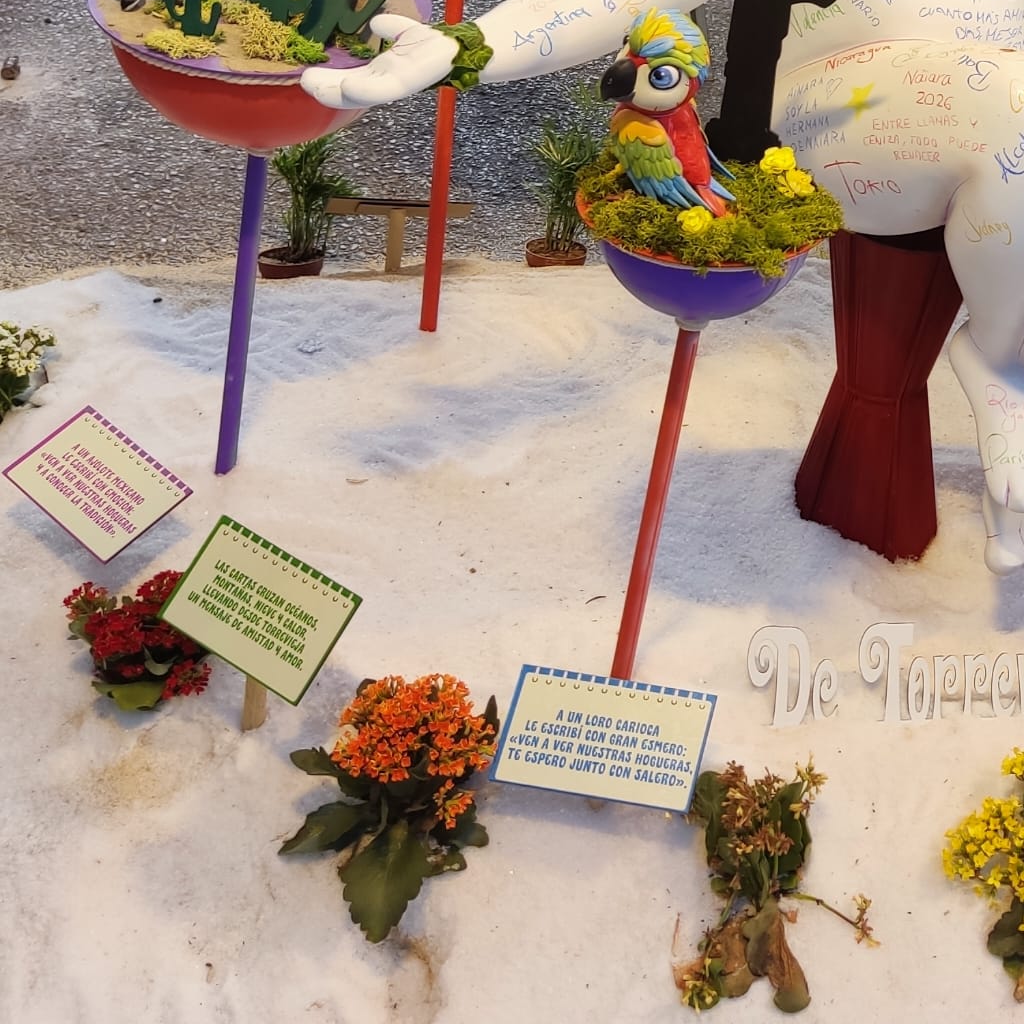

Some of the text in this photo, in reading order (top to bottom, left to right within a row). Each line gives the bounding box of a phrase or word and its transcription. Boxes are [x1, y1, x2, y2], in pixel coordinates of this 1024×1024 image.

[512, 7, 593, 57] Argentina
[824, 45, 892, 72] Nicaragua
[915, 91, 954, 110] 2026
[785, 115, 830, 137] HERMANA
[872, 117, 911, 131] ENTRE
[949, 135, 988, 153] PUEDE
[893, 150, 941, 163] RENACER
[42, 453, 59, 468] «VEN
[62, 469, 76, 482] VER
[73, 480, 106, 508] NUESTRAS
[103, 505, 136, 534] HOGUERAS
[62, 452, 134, 515] LE ESCRIBÍ CON EMOCIÓN:
[78, 448, 90, 459] UN
[86, 456, 115, 479] AJOLOTE
[111, 476, 144, 505] MEXICANO
[46, 474, 74, 498] CONOCER
[71, 495, 82, 505] LA
[80, 502, 115, 538] TRADICIÓN».
[213, 575, 307, 641] MONTAÑAS, NIEVE Y CALOR,
[215, 560, 318, 631] LAS CARTAS CRUZAN OCÉANOS,
[188, 591, 303, 671] UN MENSAJE DE AMISTAD Y AMOR.
[202, 584, 304, 654] LLEVANDO DESDE TORREVIEJA
[746, 624, 838, 728] De
[525, 720, 686, 756] LE ESCRIBÍ CON GRAN ESMERO:
[556, 710, 659, 737] A UN LORO CARIOCA
[508, 748, 686, 788] TE ESPERO JUNTO CON SALERO».
[510, 734, 692, 774] «VEN A VER NUESTRAS HOGUERAS,
